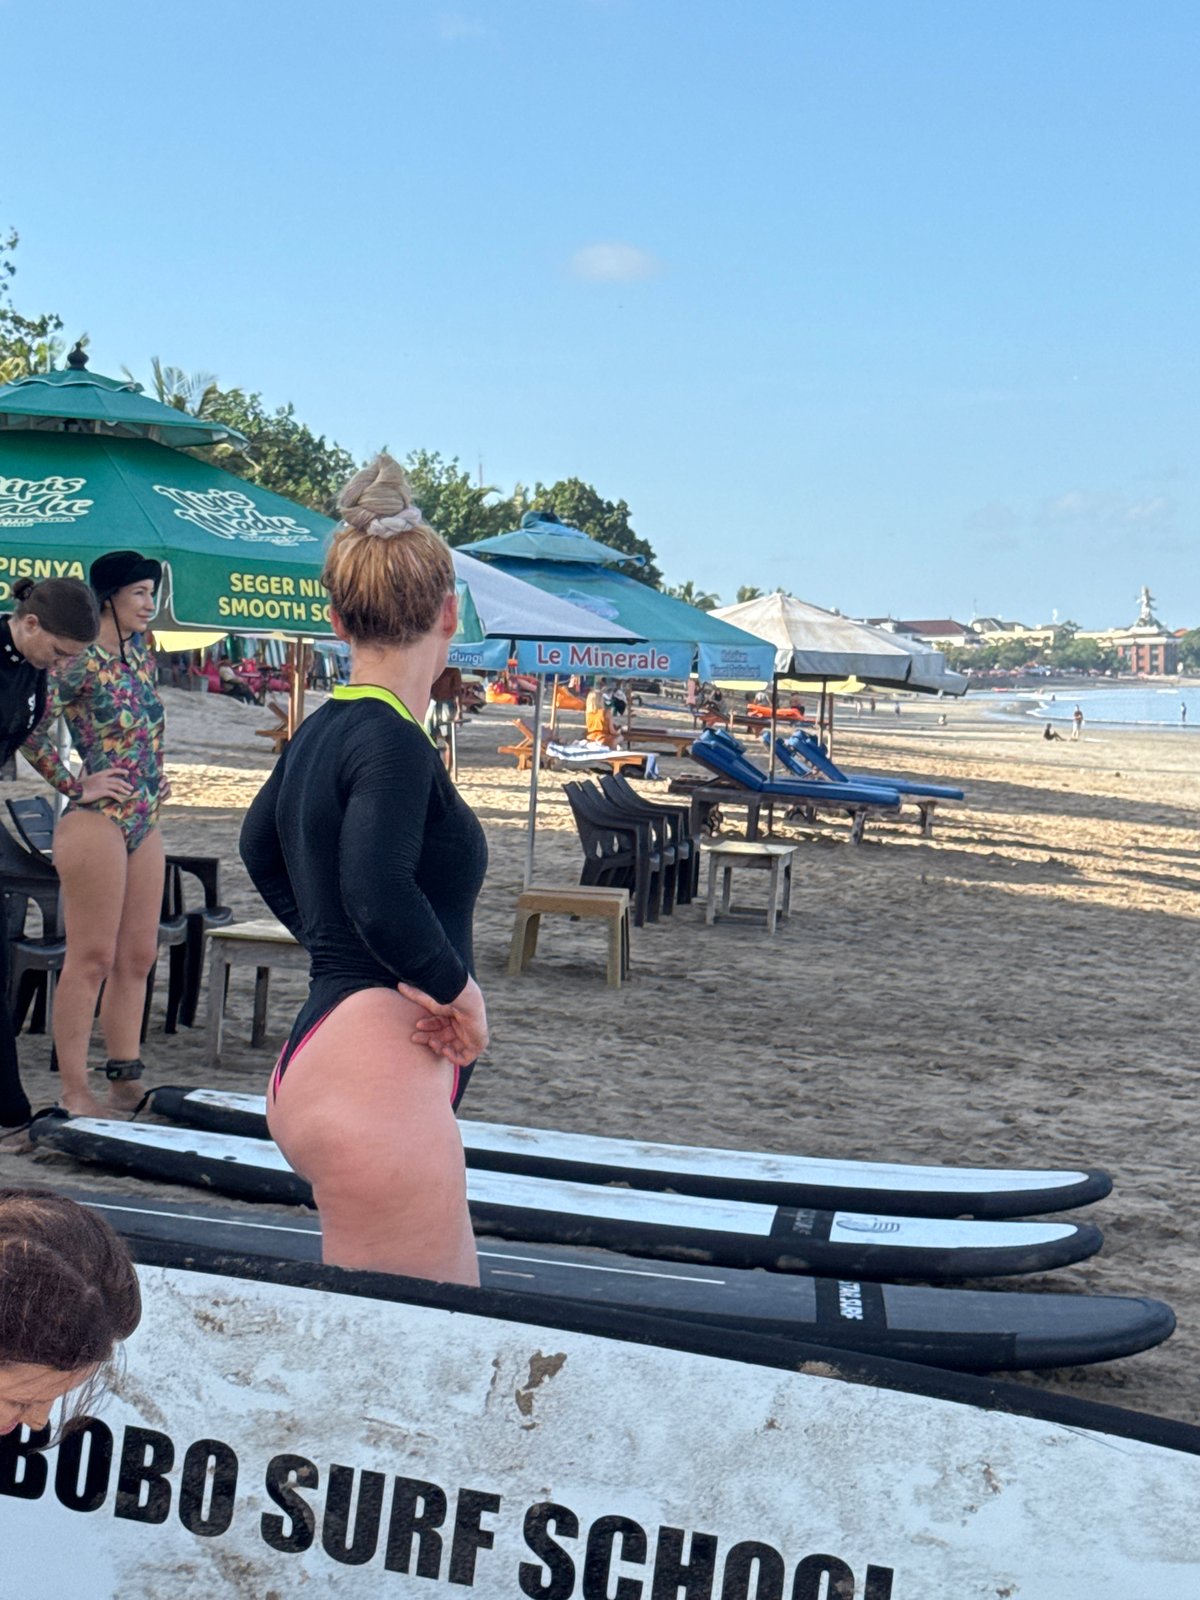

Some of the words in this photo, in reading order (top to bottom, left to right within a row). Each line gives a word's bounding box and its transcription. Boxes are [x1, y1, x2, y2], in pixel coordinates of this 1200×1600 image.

[0, 476, 87, 502] ipis
[230, 573, 295, 596] SEGER
[218, 597, 306, 621] SMOOTH
[537, 643, 561, 665] Le
[569, 645, 669, 671] Minerale
[0, 1416, 239, 1537] BOBO
[260, 1454, 501, 1587] SURF
